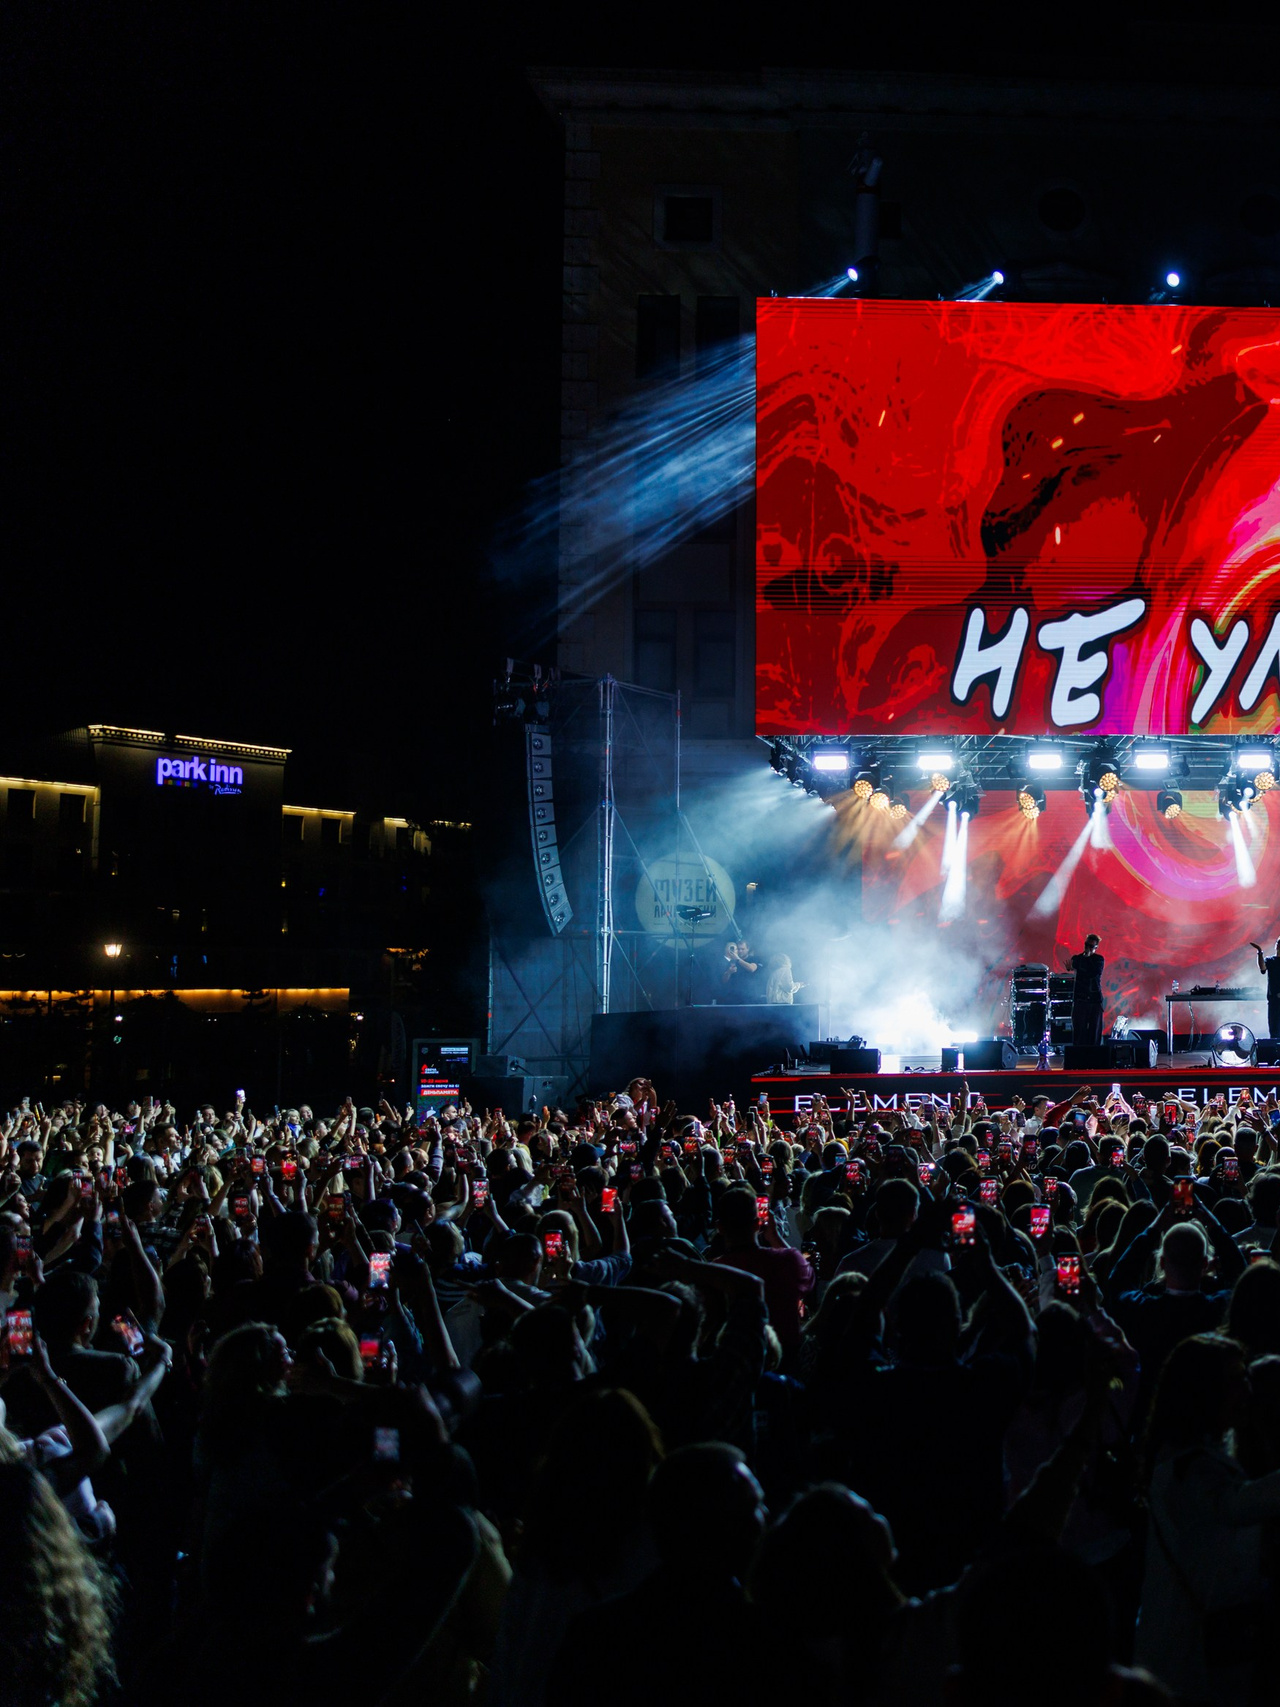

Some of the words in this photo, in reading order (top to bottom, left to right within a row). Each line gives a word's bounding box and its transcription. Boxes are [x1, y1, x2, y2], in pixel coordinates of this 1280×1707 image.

[951, 598, 1146, 728] НЕ
[157, 756, 208, 785] park
[210, 758, 243, 785] inn
